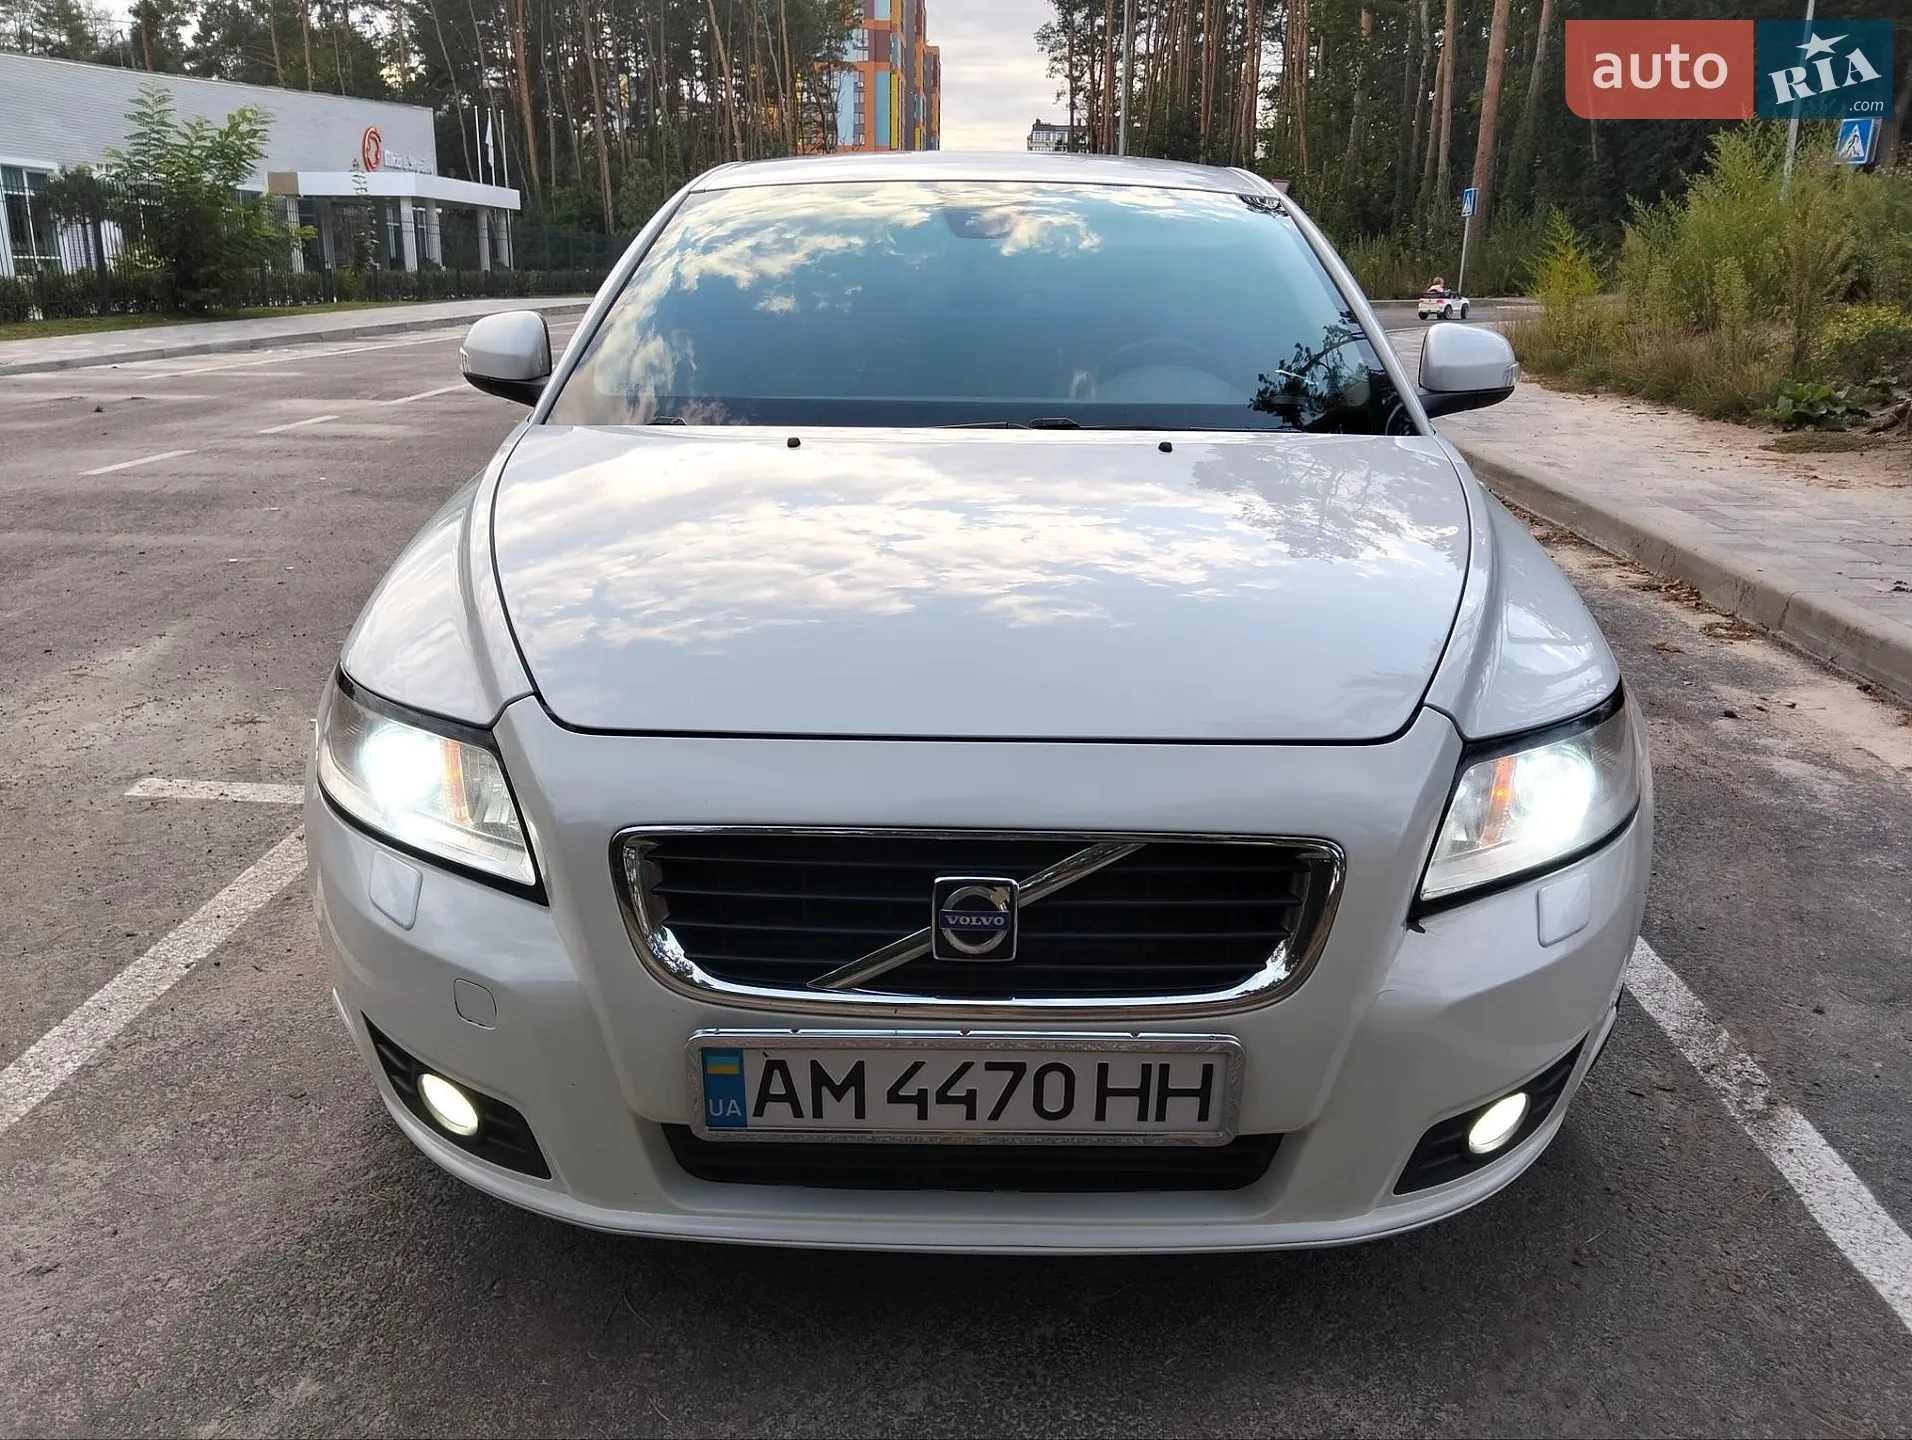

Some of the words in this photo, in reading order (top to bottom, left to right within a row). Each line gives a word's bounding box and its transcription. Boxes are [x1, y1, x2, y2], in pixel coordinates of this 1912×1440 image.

[944, 915, 1005, 926] VOLVO
[752, 1058, 867, 1120] AM
[886, 1060, 1076, 1121] 4470
[1094, 1062, 1215, 1122] HH
[708, 1098, 742, 1117] UA
